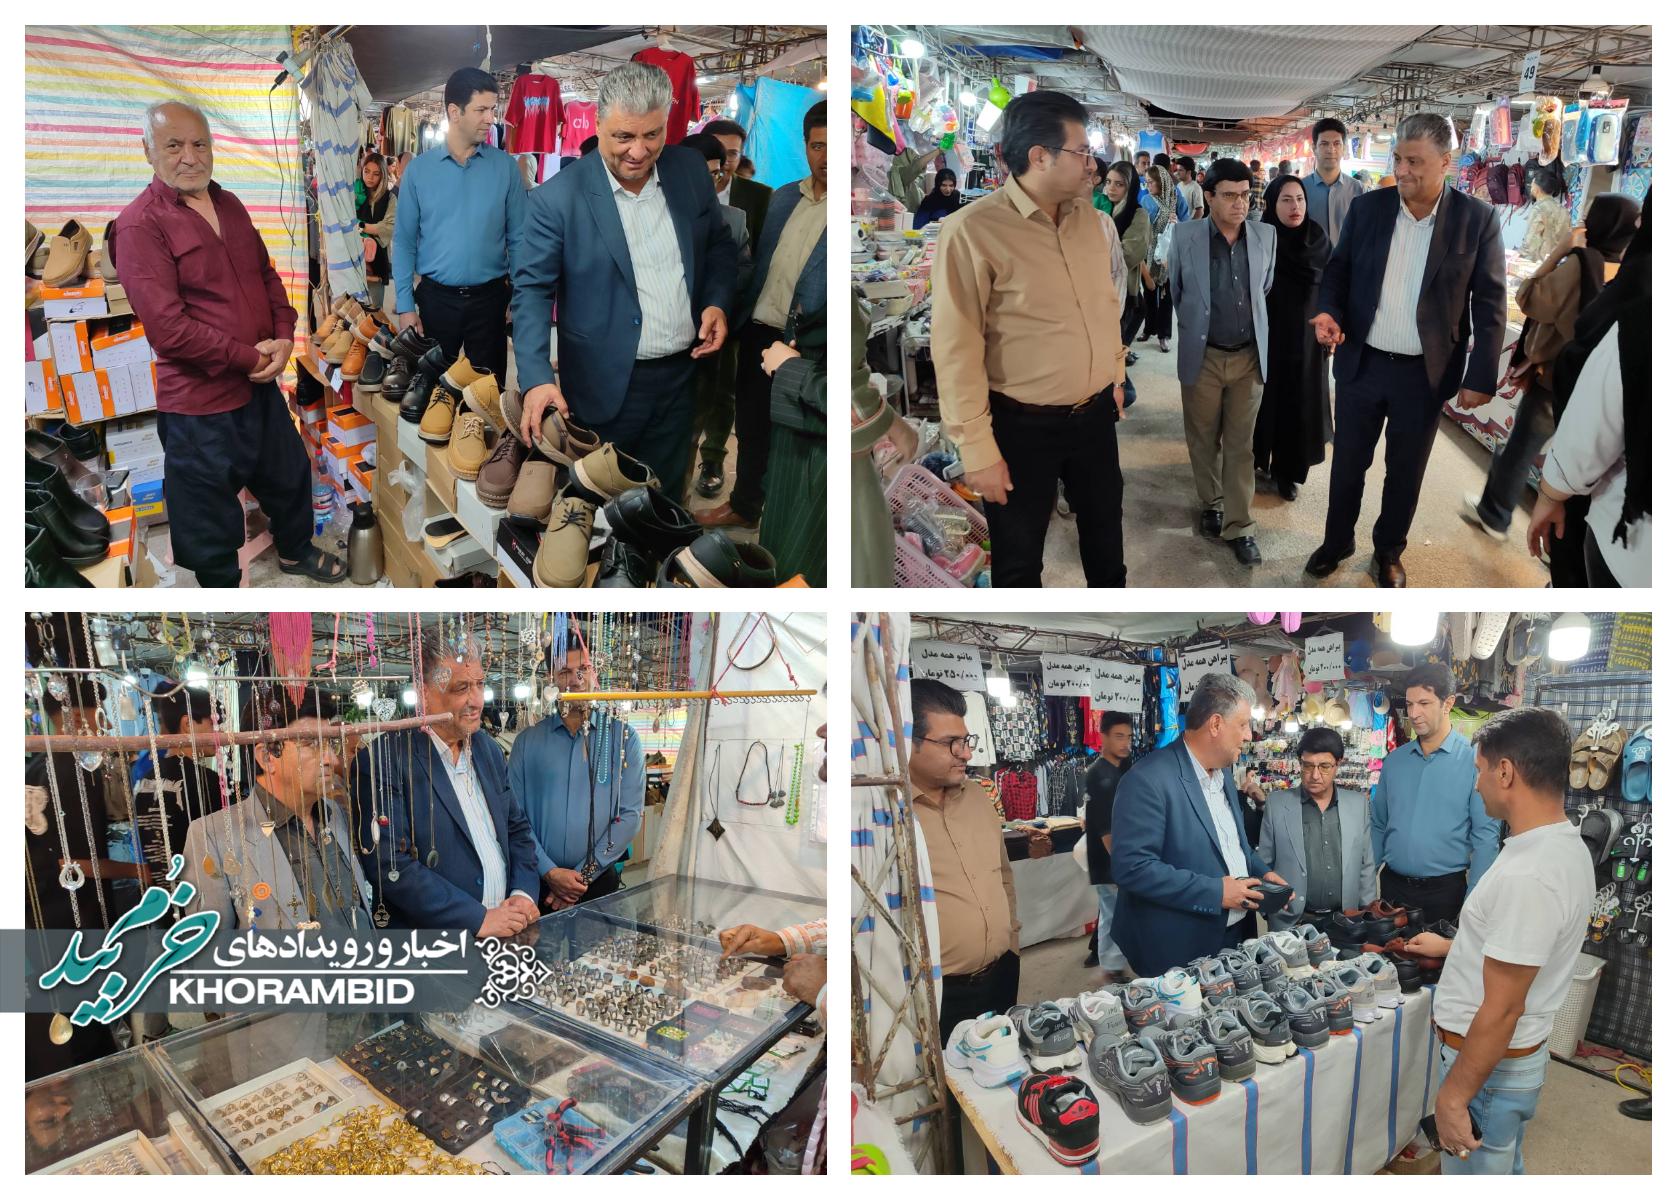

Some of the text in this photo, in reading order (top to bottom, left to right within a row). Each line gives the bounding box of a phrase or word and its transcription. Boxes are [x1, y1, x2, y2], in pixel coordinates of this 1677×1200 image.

[1523, 65, 1536, 80] 49
[921, 648, 973, 662] مانتو همه مدل
[1046, 661, 1060, 671] مدل
[1073, 663, 1091, 673] پیراهن
[1182, 653, 1228, 671] پیراهن همه مدل
[1094, 668, 1141, 685] پیراهن همه مدل
[1047, 679, 1090, 690] ۲۰۰/۰۰ تومان
[1094, 691, 1114, 703] تومان
